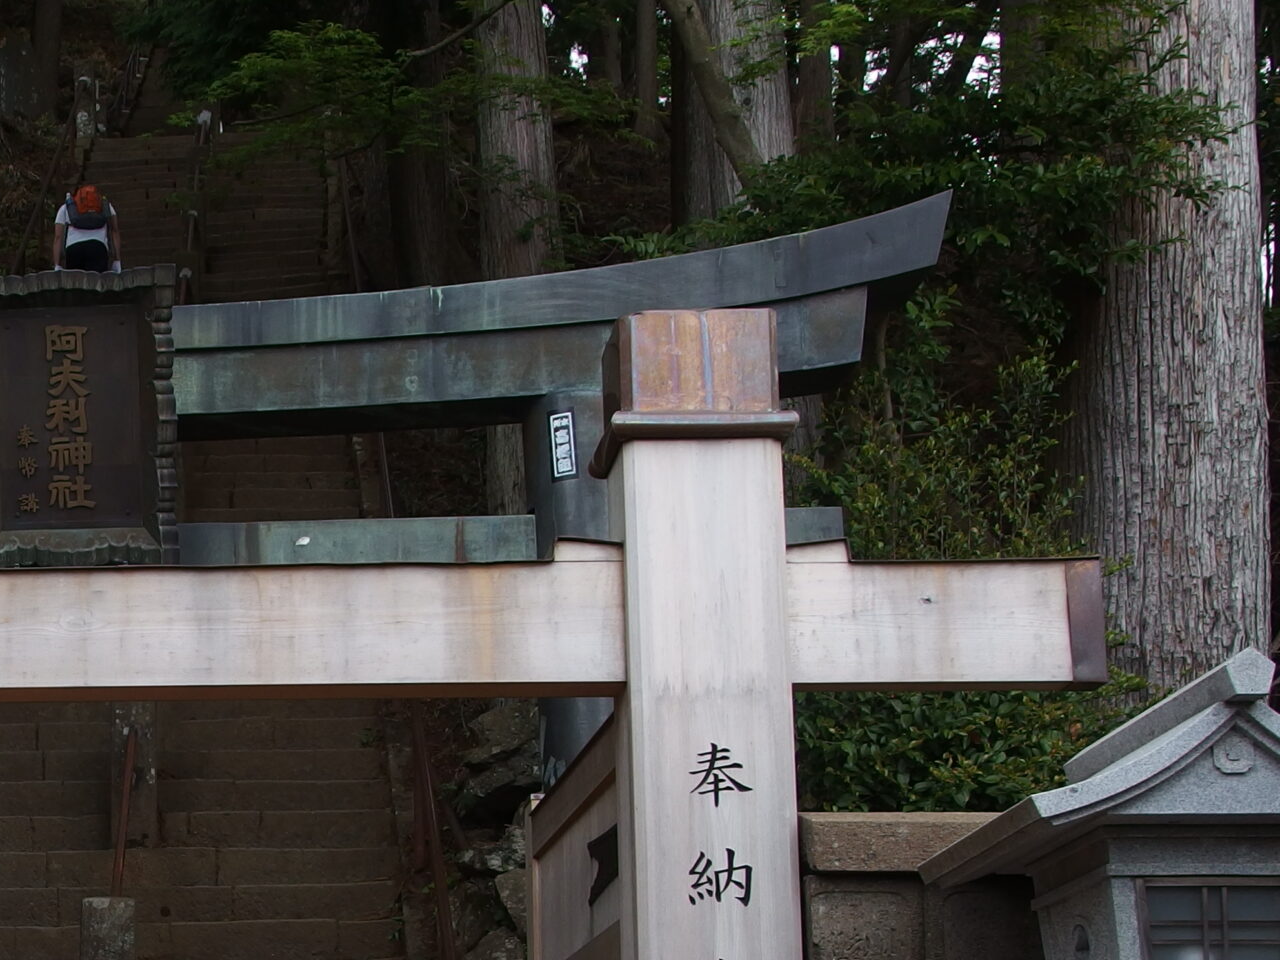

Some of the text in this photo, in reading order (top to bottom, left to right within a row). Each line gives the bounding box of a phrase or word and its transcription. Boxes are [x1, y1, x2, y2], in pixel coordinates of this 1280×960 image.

[44, 324, 96, 510] 阿夫利神社
[687, 742, 754, 907] 奉納
